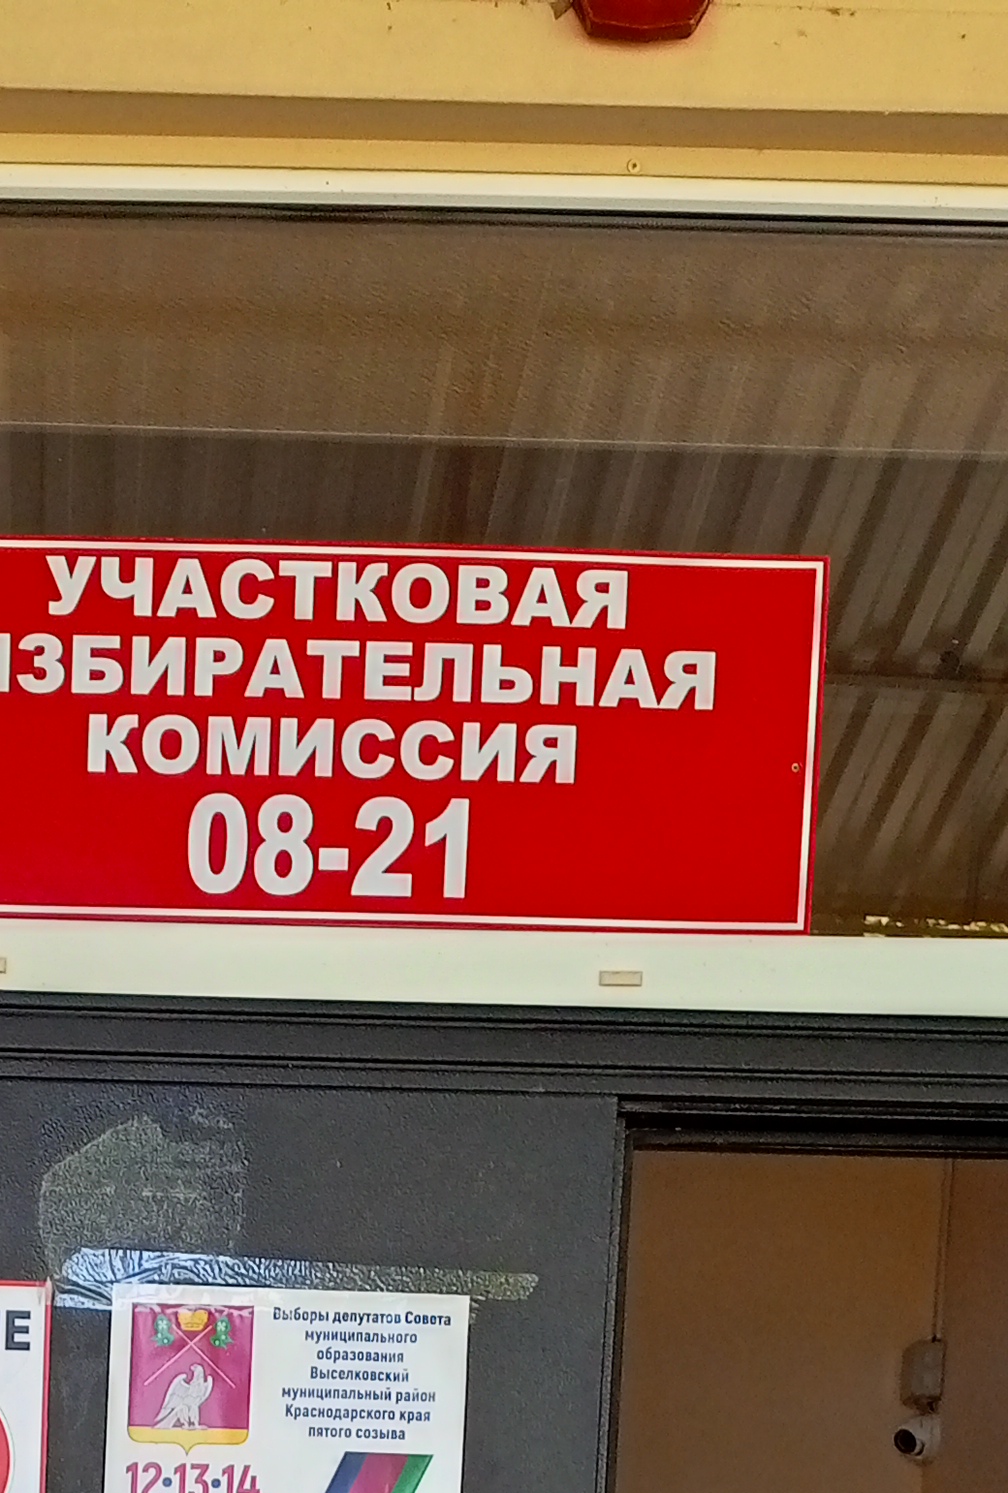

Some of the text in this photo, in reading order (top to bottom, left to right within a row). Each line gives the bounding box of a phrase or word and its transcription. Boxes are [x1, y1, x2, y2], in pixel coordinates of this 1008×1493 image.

[46, 556, 628, 629] УЧАСТКОВАЯ
[88, 714, 576, 783] КОМИССИЯ
[188, 793, 469, 898] 08-21
[273, 1307, 451, 1326] Выборы депутатов Совета
[305, 1330, 417, 1344] муниципального
[317, 1346, 404, 1364] образования
[310, 1366, 409, 1382] Выселковский
[282, 1387, 436, 1405] муниципальный район
[285, 1404, 430, 1424] Краснодарского края
[308, 1427, 405, 1440] пятого созыва
